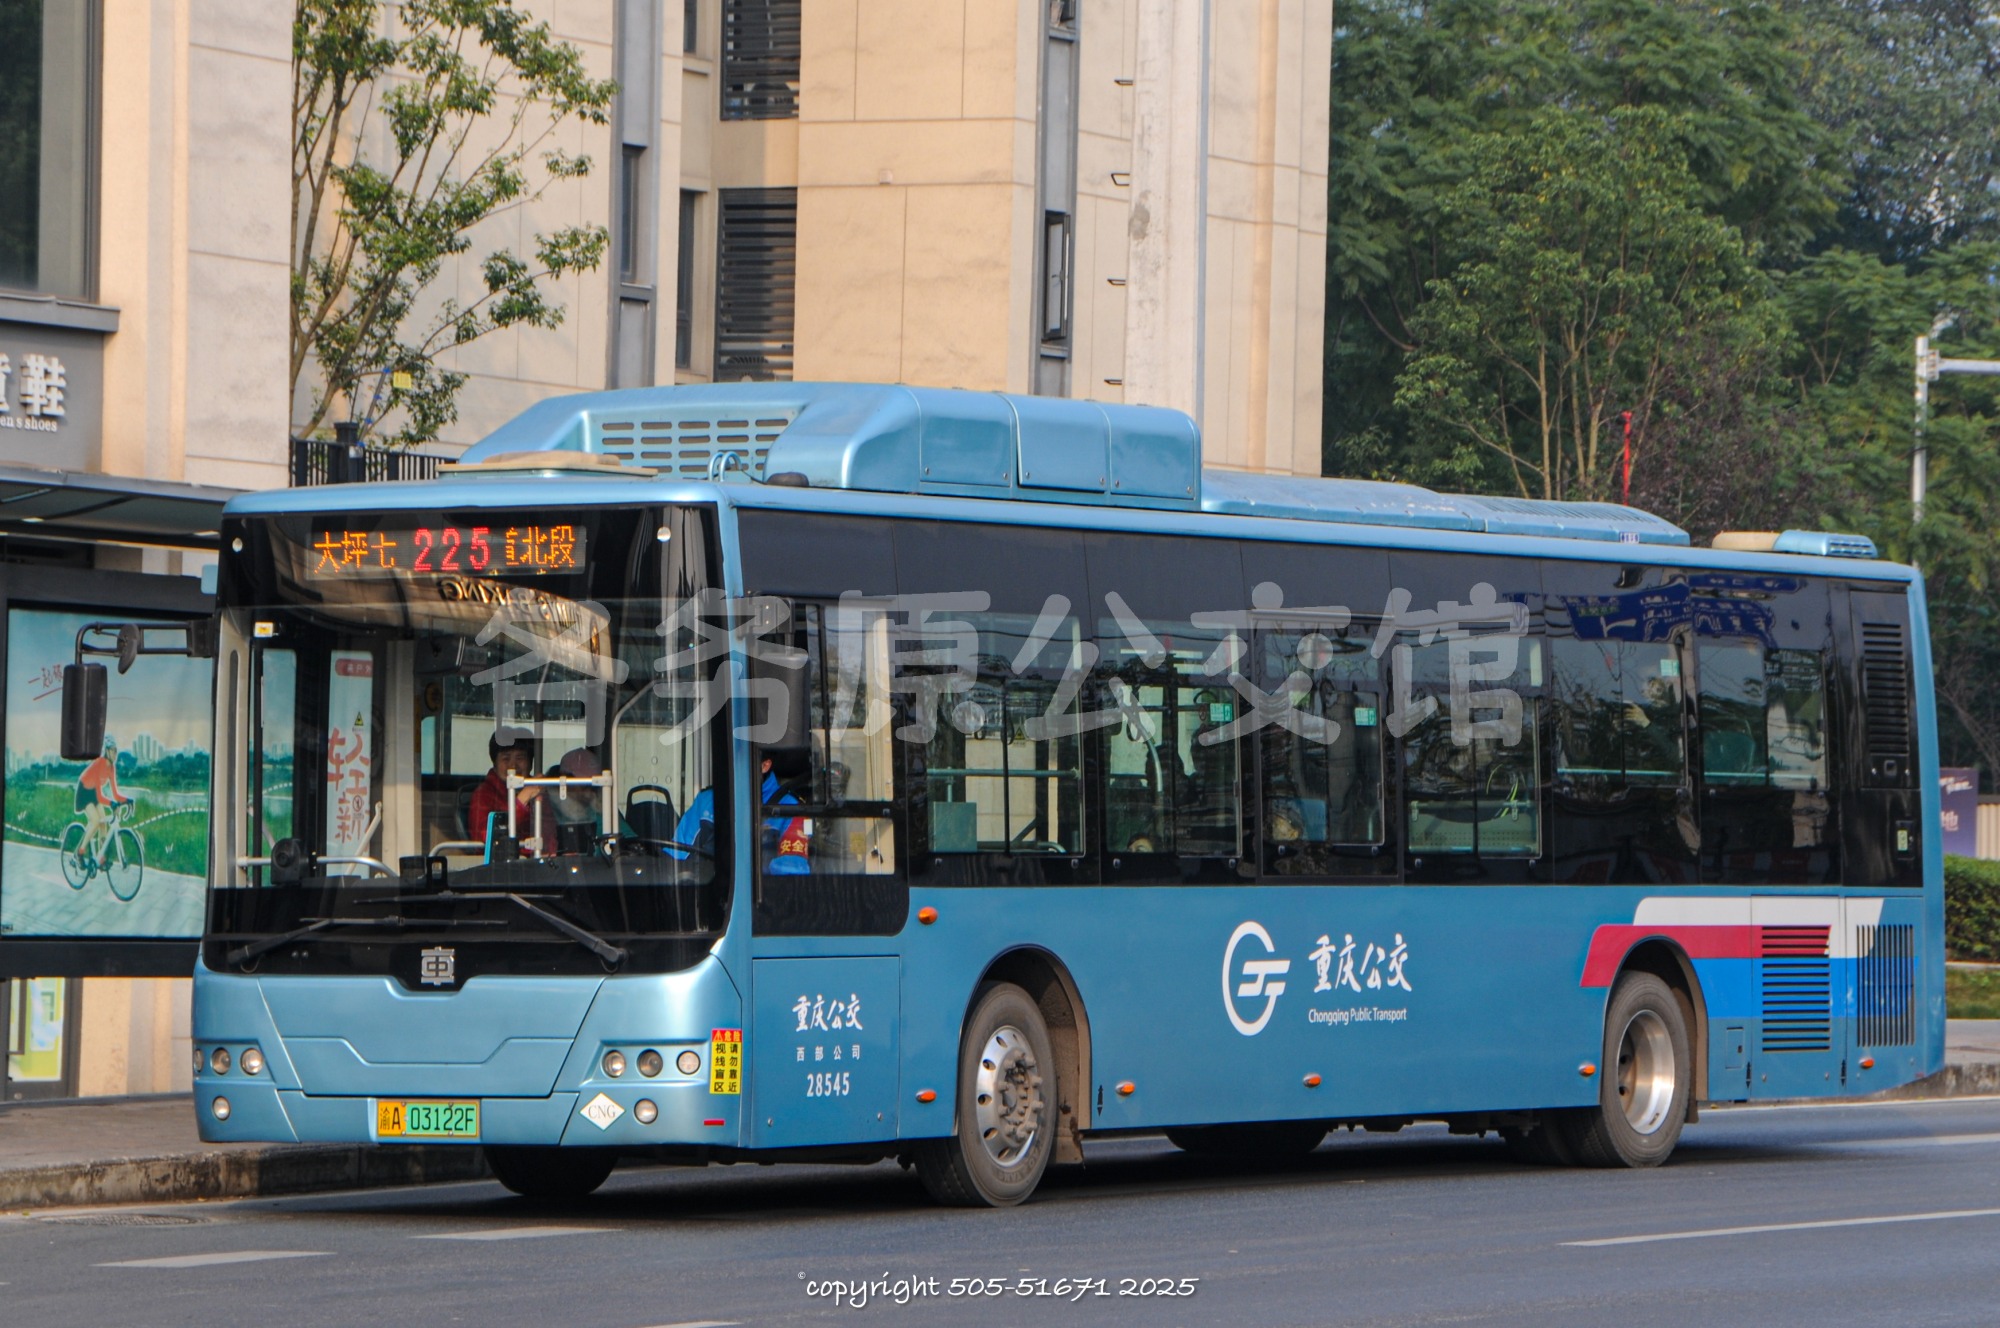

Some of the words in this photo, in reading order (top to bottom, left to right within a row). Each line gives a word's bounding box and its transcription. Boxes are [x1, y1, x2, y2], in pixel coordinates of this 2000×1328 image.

[24, 416, 58, 432] shoes
[314, 531, 397, 573] 大坪七
[414, 527, 489, 571] 225
[780, 840, 808, 854] 安全
[1308, 933, 1412, 993] 重庆公交
[792, 993, 863, 1032] 重庆公交
[1308, 1008, 1349, 1026] Chongqing
[1350, 1007, 1372, 1021] Public
[1373, 1007, 1407, 1023] Transport
[796, 1044, 861, 1061] 西部公司
[806, 1072, 850, 1097] 28545
[588, 1104, 616, 1119] CNG
